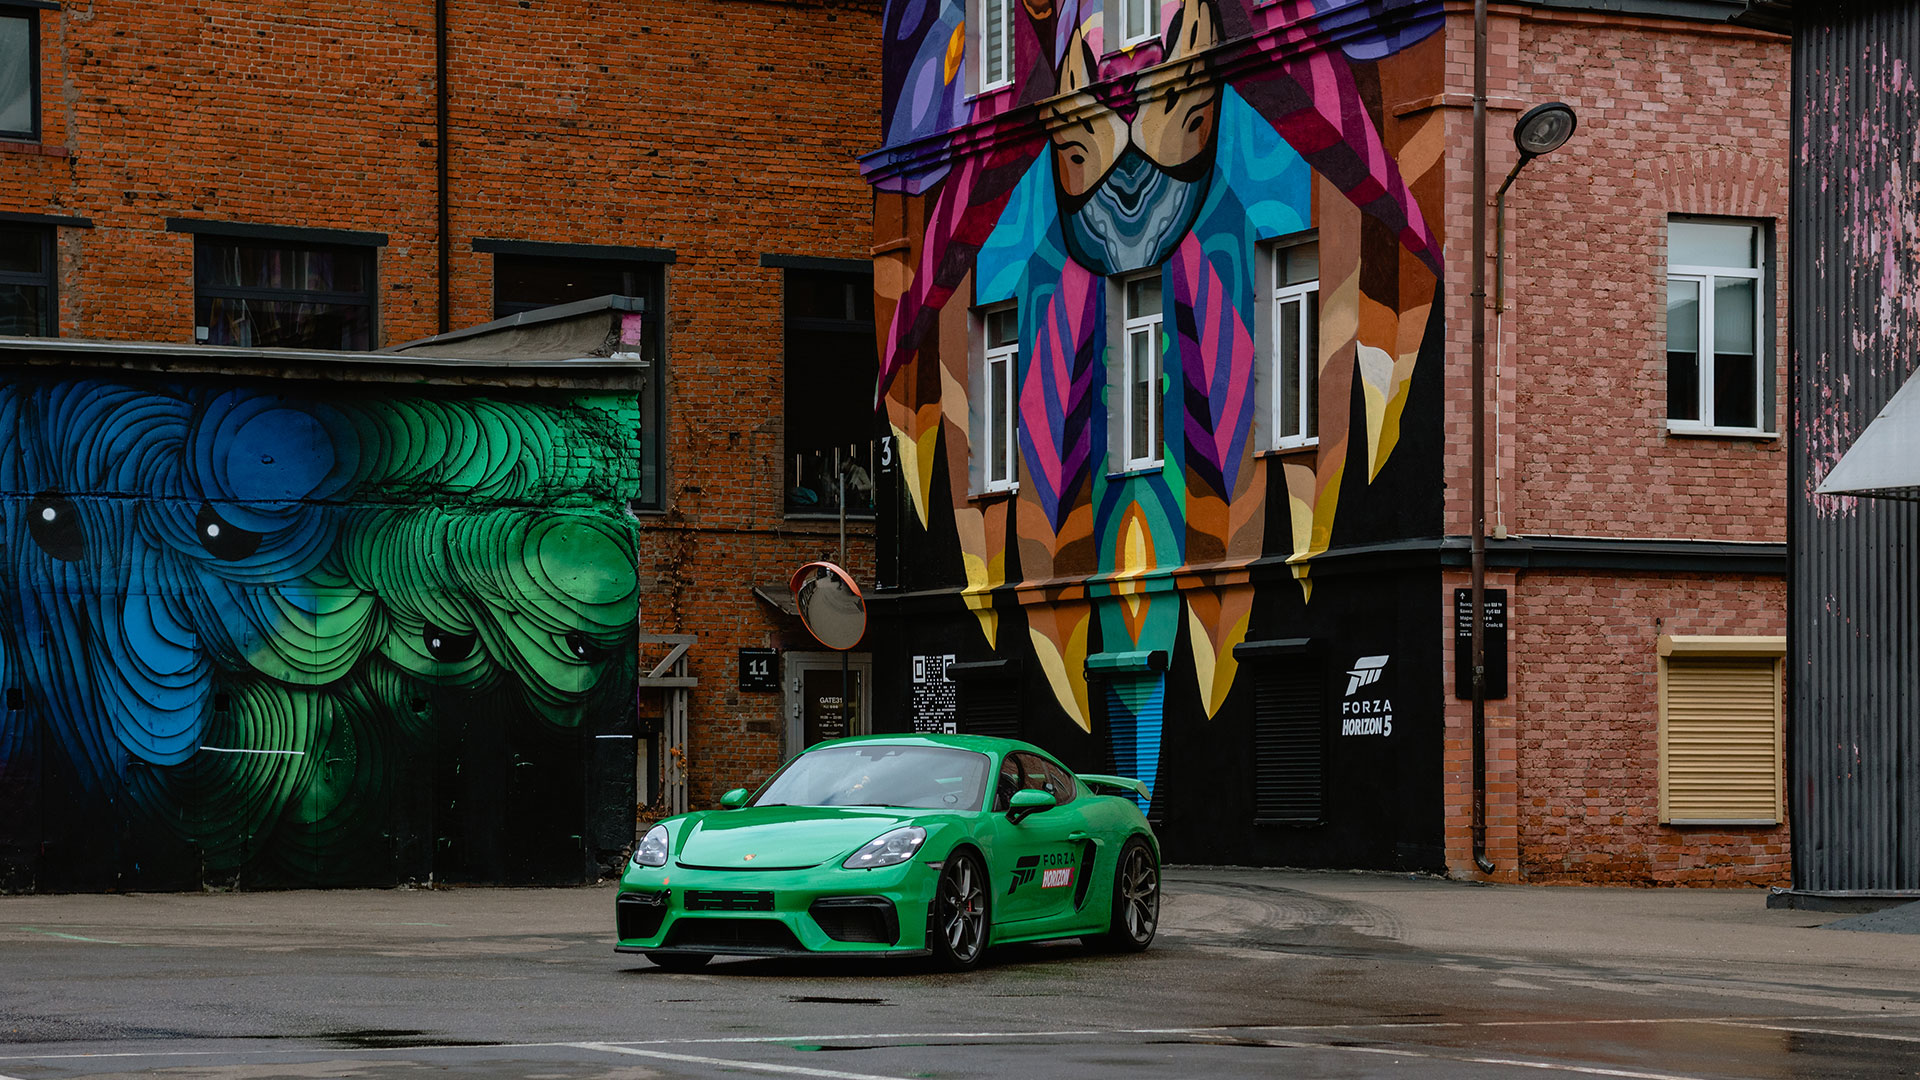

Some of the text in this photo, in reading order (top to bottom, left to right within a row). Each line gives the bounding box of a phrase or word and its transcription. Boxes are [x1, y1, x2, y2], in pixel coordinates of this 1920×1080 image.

[881, 436, 892, 467] 3
[749, 660, 769, 676] 11
[819, 696, 843, 704] GATE31
[1342, 699, 1392, 715] FORZA
[1342, 715, 1392, 737] HORIZON 5
[1043, 852, 1075, 866] FORZA
[1041, 868, 1071, 889] HORIZON
